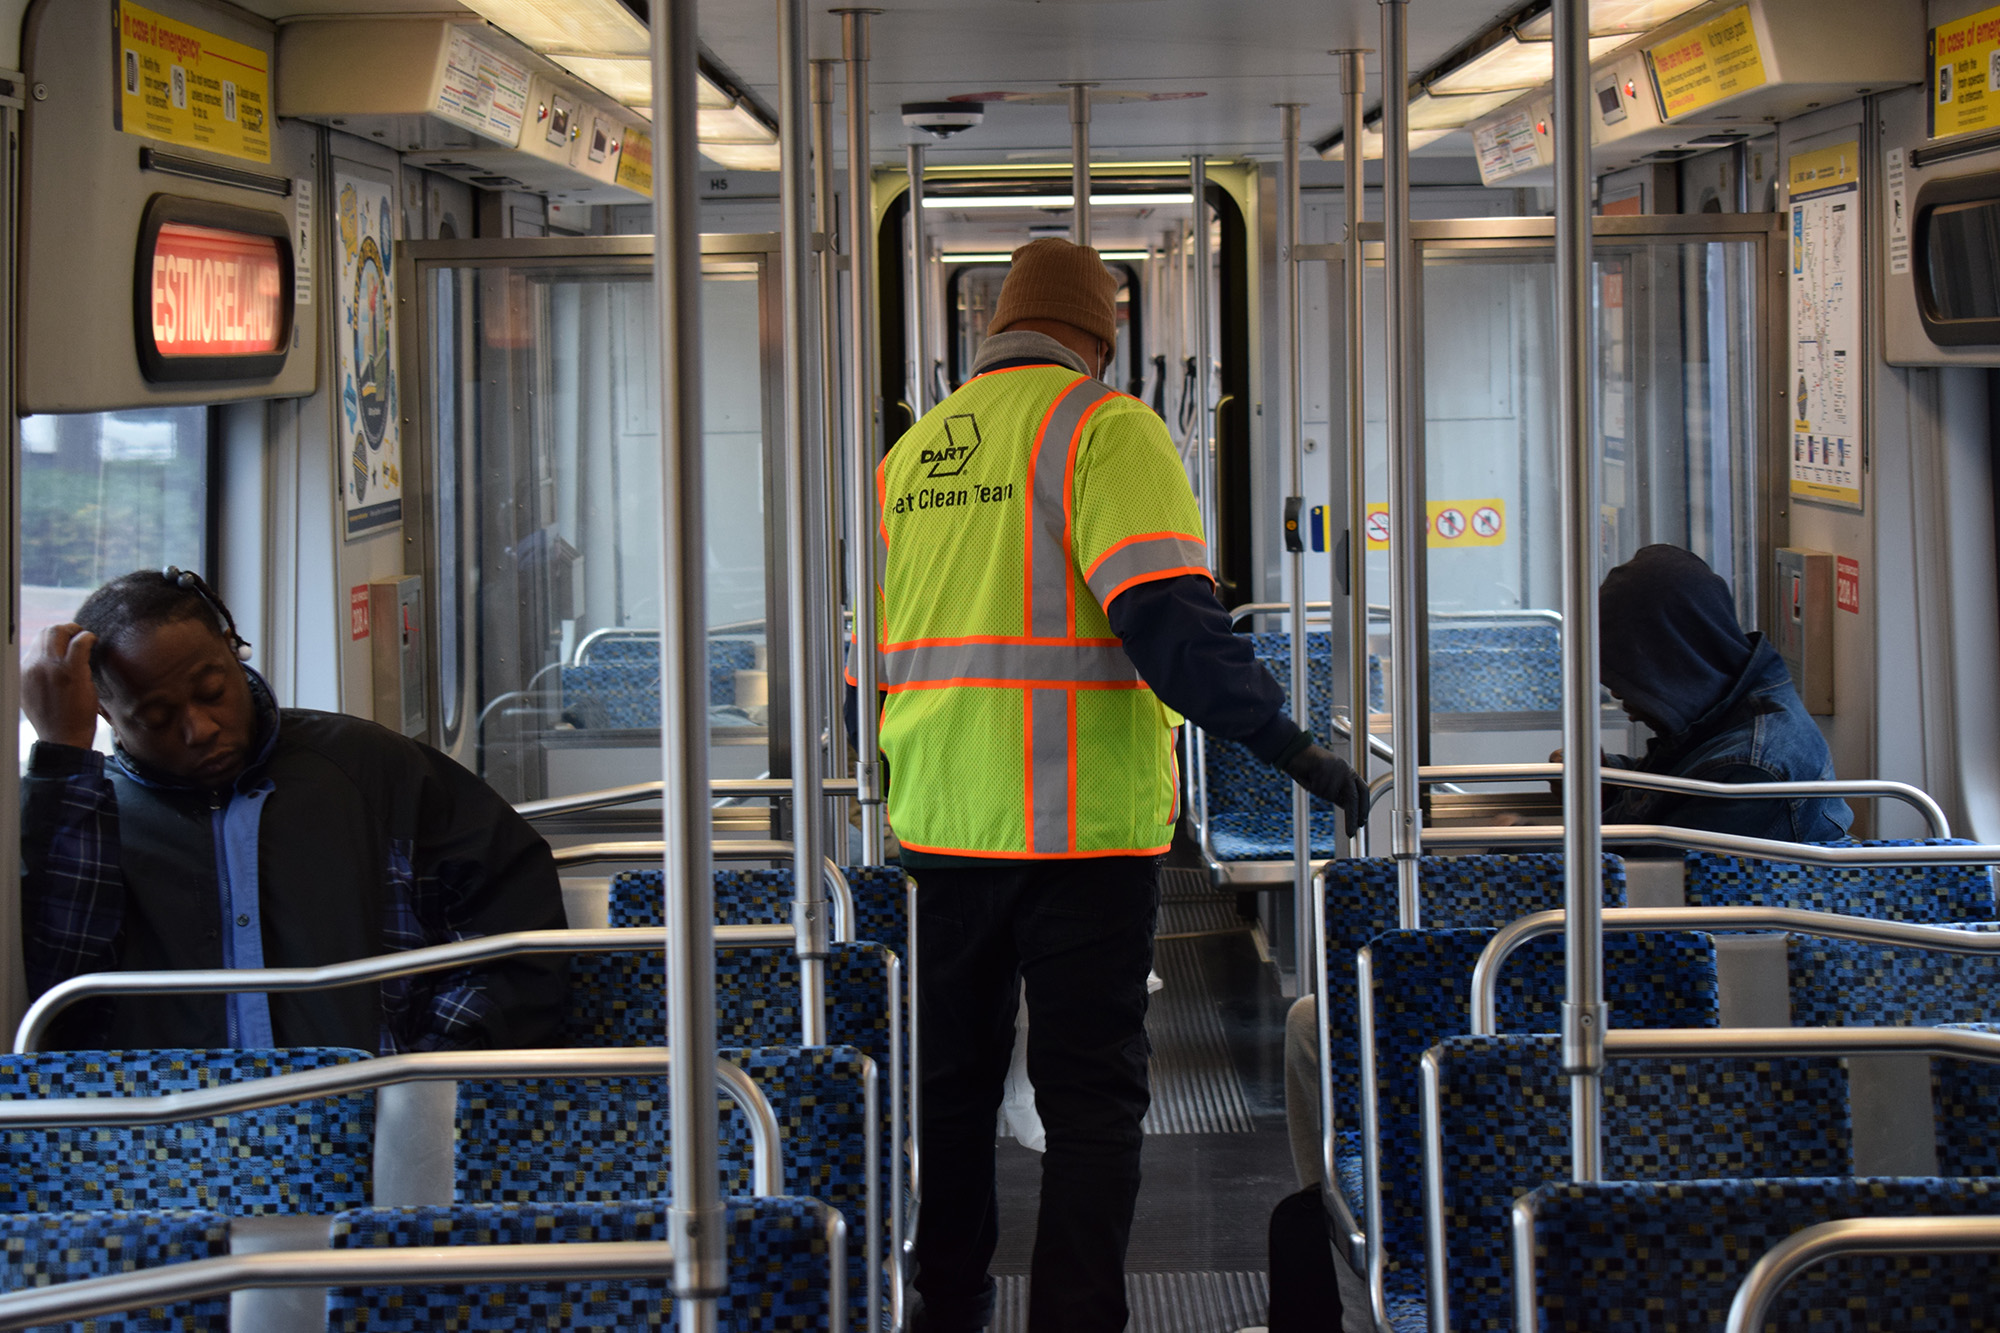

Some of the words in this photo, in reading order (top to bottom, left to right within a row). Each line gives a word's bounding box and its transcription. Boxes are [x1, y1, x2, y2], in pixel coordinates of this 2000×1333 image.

[132, 18, 149, 44] case
[1938, 32, 1946, 56] In
[1947, 30, 1965, 53] case
[1967, 21, 1975, 47] of
[711, 179, 728, 190] H5
[921, 446, 969, 464] DART
[919, 488, 968, 509] Clean
